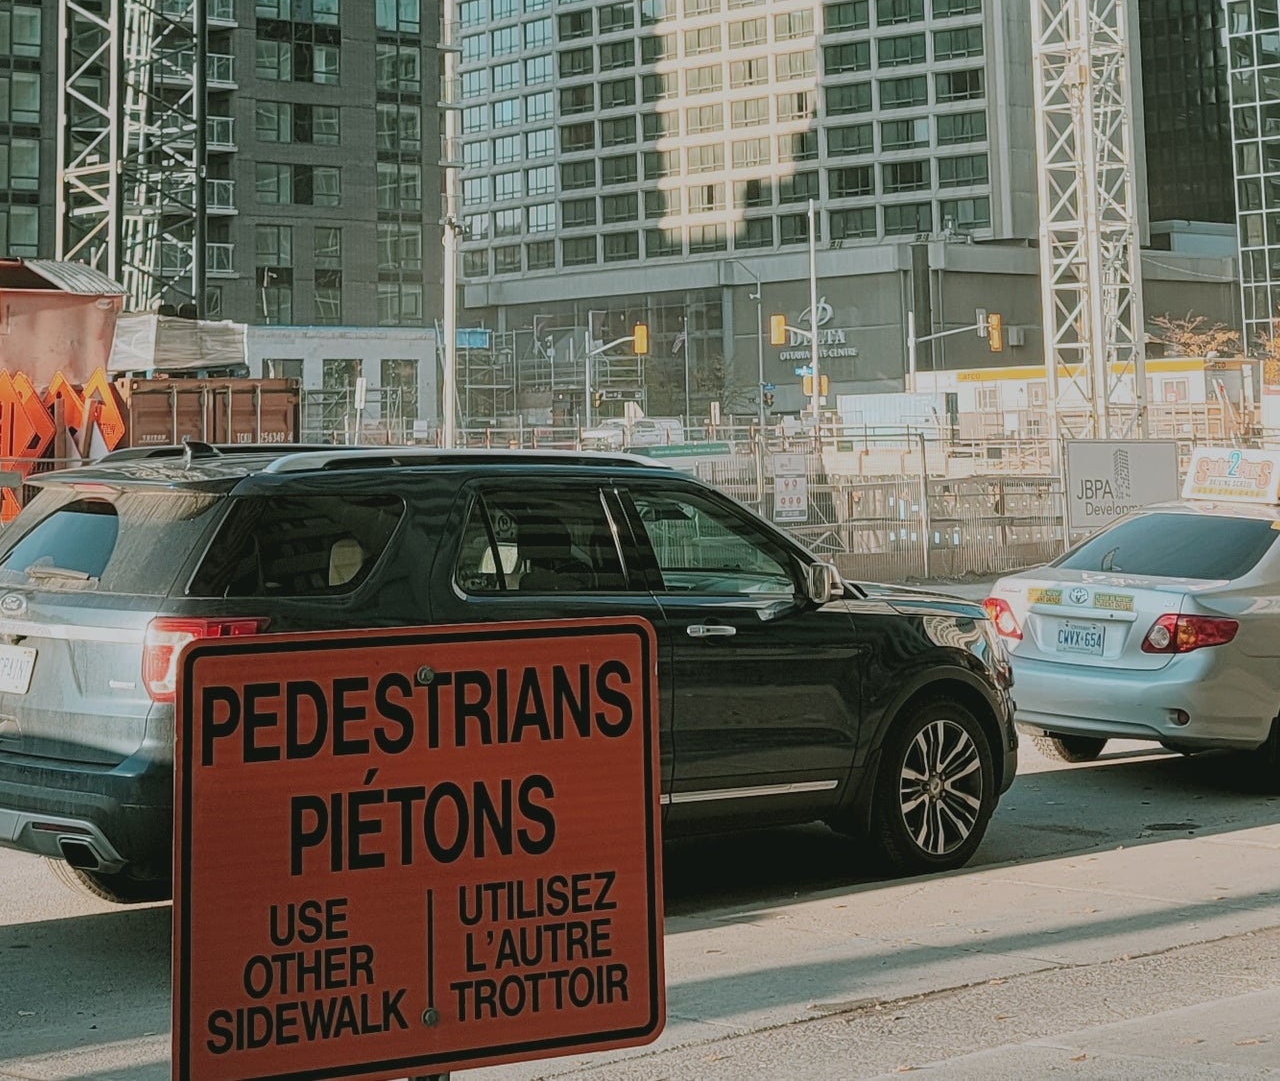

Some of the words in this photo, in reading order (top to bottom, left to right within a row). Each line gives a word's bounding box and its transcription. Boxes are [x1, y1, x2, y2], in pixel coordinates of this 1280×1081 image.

[790, 329, 846, 347] DETA
[1077, 479, 1114, 500] JBPA
[1058, 629, 1081, 646] CWVX
[1084, 633, 1102, 648] 654
[201, 660, 633, 767] PEDESTRIANS
[291, 768, 556, 877] PIÉTONS
[269, 898, 348, 947] USE
[458, 871, 617, 926] UTILISEZ
[243, 945, 374, 999] OTHER
[465, 918, 612, 974] L'AUTRE
[450, 964, 629, 1022] TROTTOIR
[206, 989, 408, 1056] SIDEWALK
